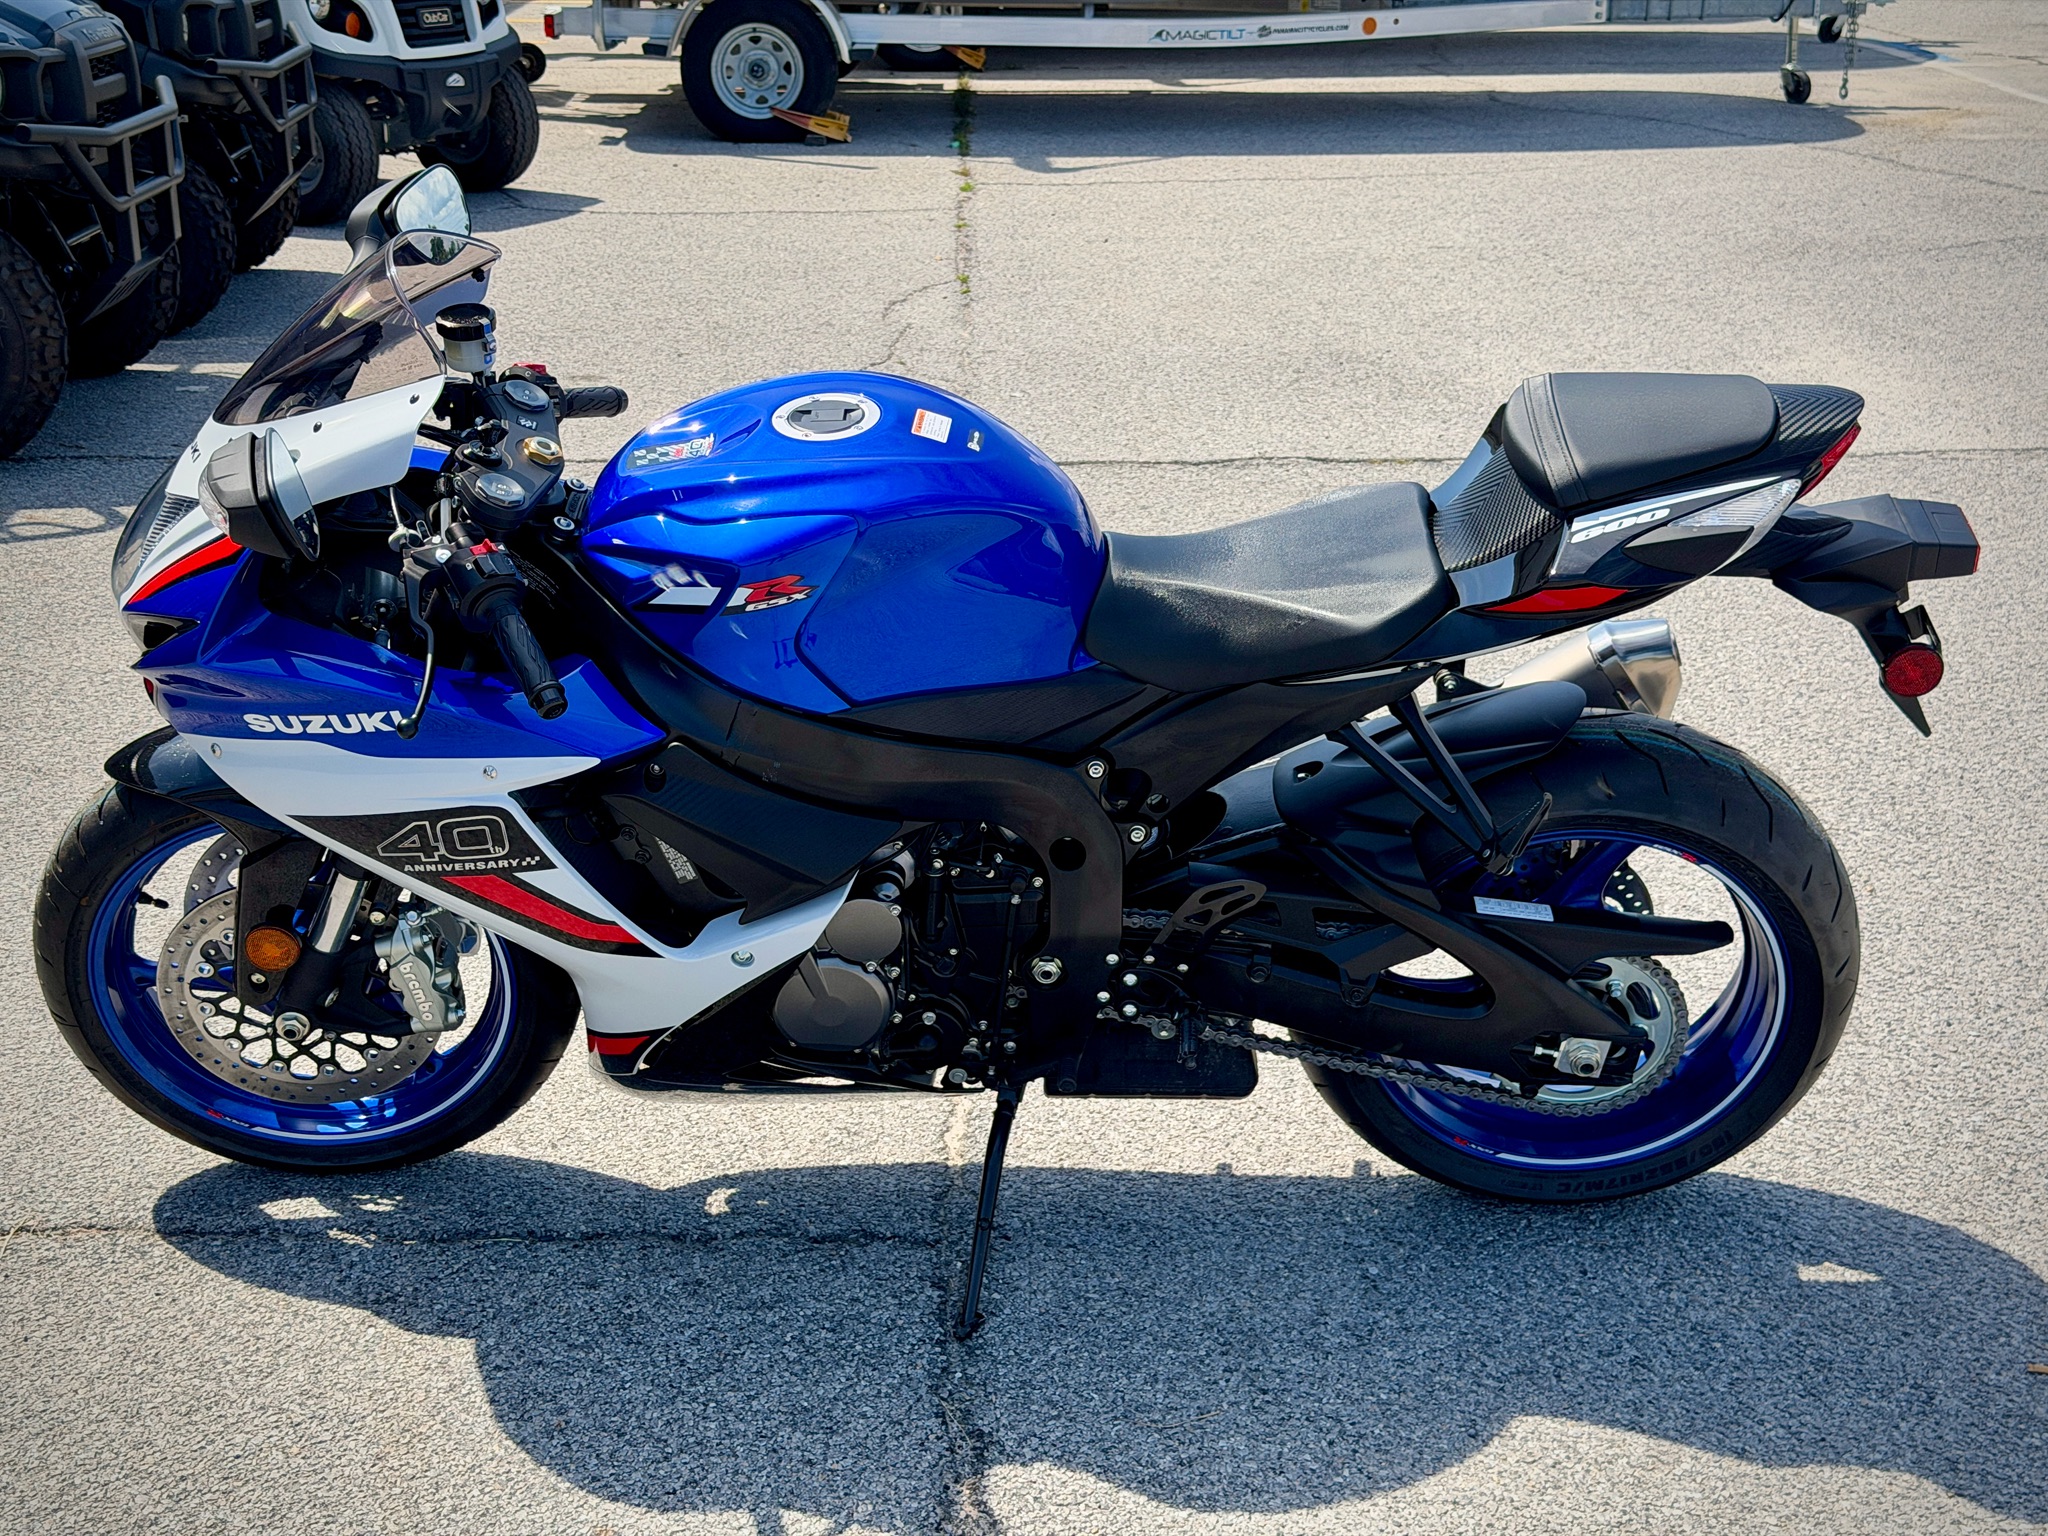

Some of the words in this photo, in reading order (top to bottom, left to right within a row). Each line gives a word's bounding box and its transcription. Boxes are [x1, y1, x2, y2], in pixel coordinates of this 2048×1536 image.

[1570, 507, 1671, 544] 600
[403, 858, 521, 872] ANNIVERSARY
[400, 962, 433, 1021] brembo
